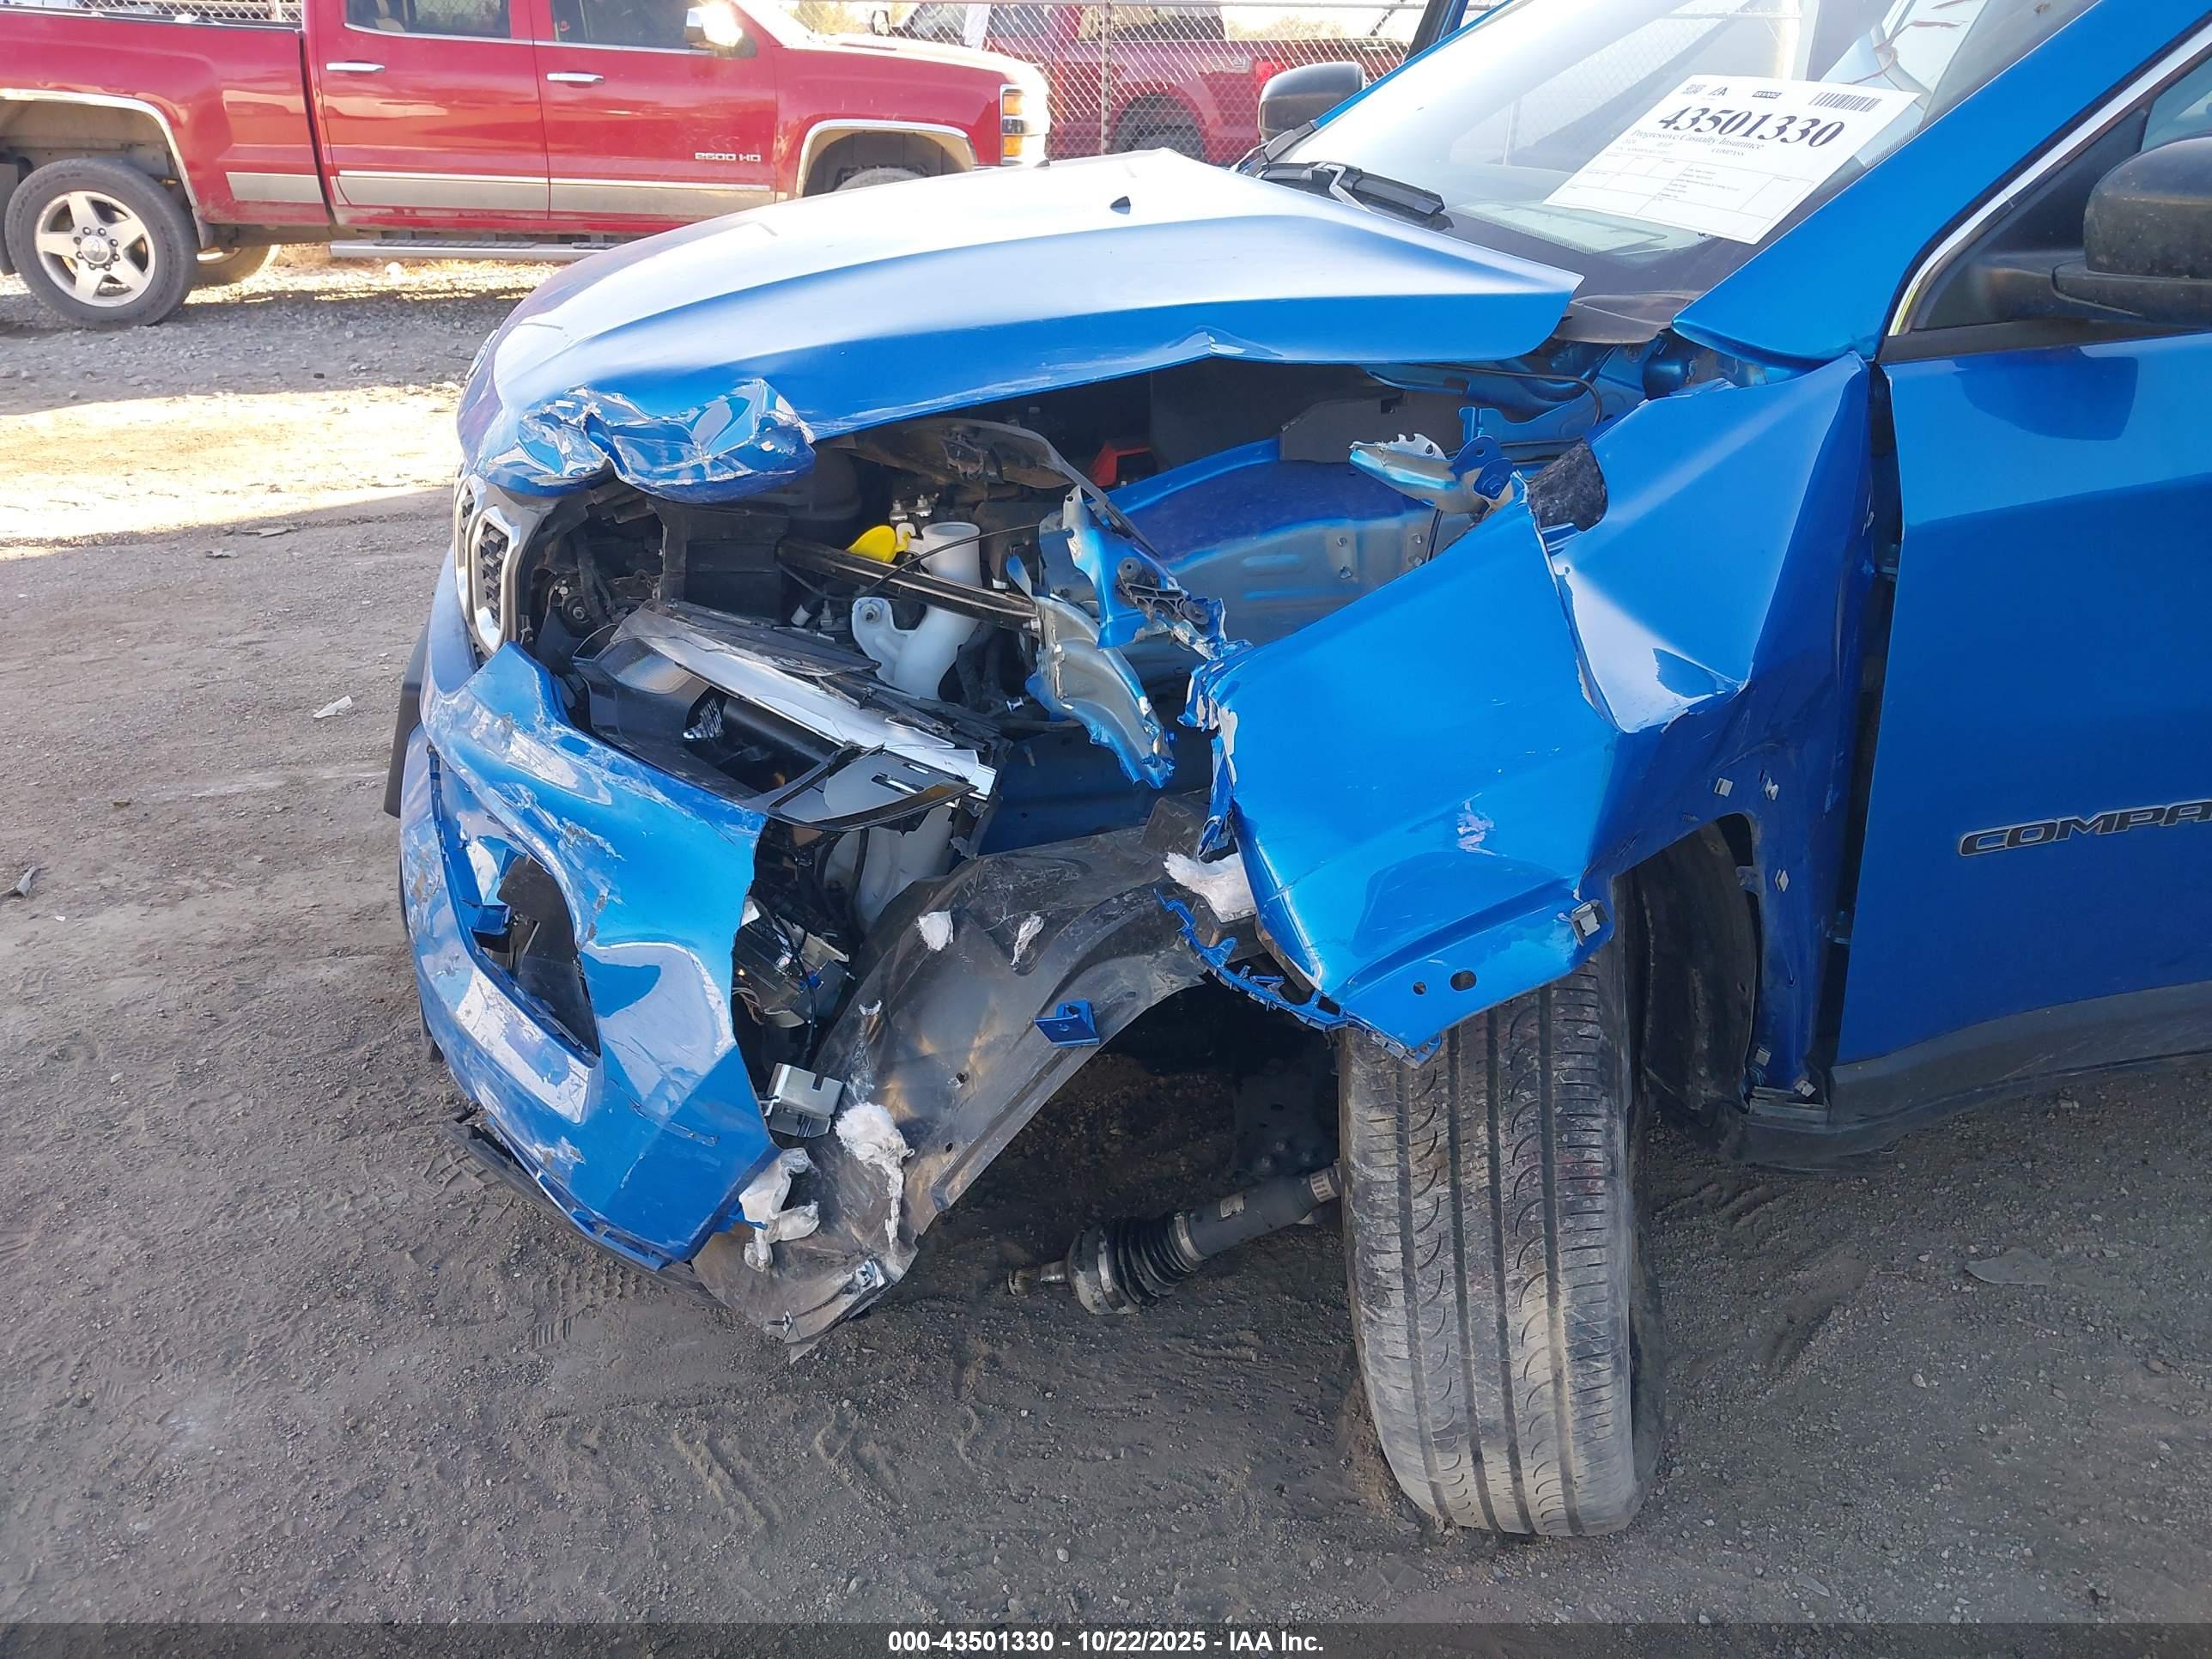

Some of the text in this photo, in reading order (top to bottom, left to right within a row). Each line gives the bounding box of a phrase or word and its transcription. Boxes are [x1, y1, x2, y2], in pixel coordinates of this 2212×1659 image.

[1631, 129, 1679, 141] Progressive
[1680, 133, 1716, 146] Casualty
[1657, 106, 1845, 148] 43501330
[738, 154, 762, 162] HD
[1958, 798, 2212, 857] COMPA
